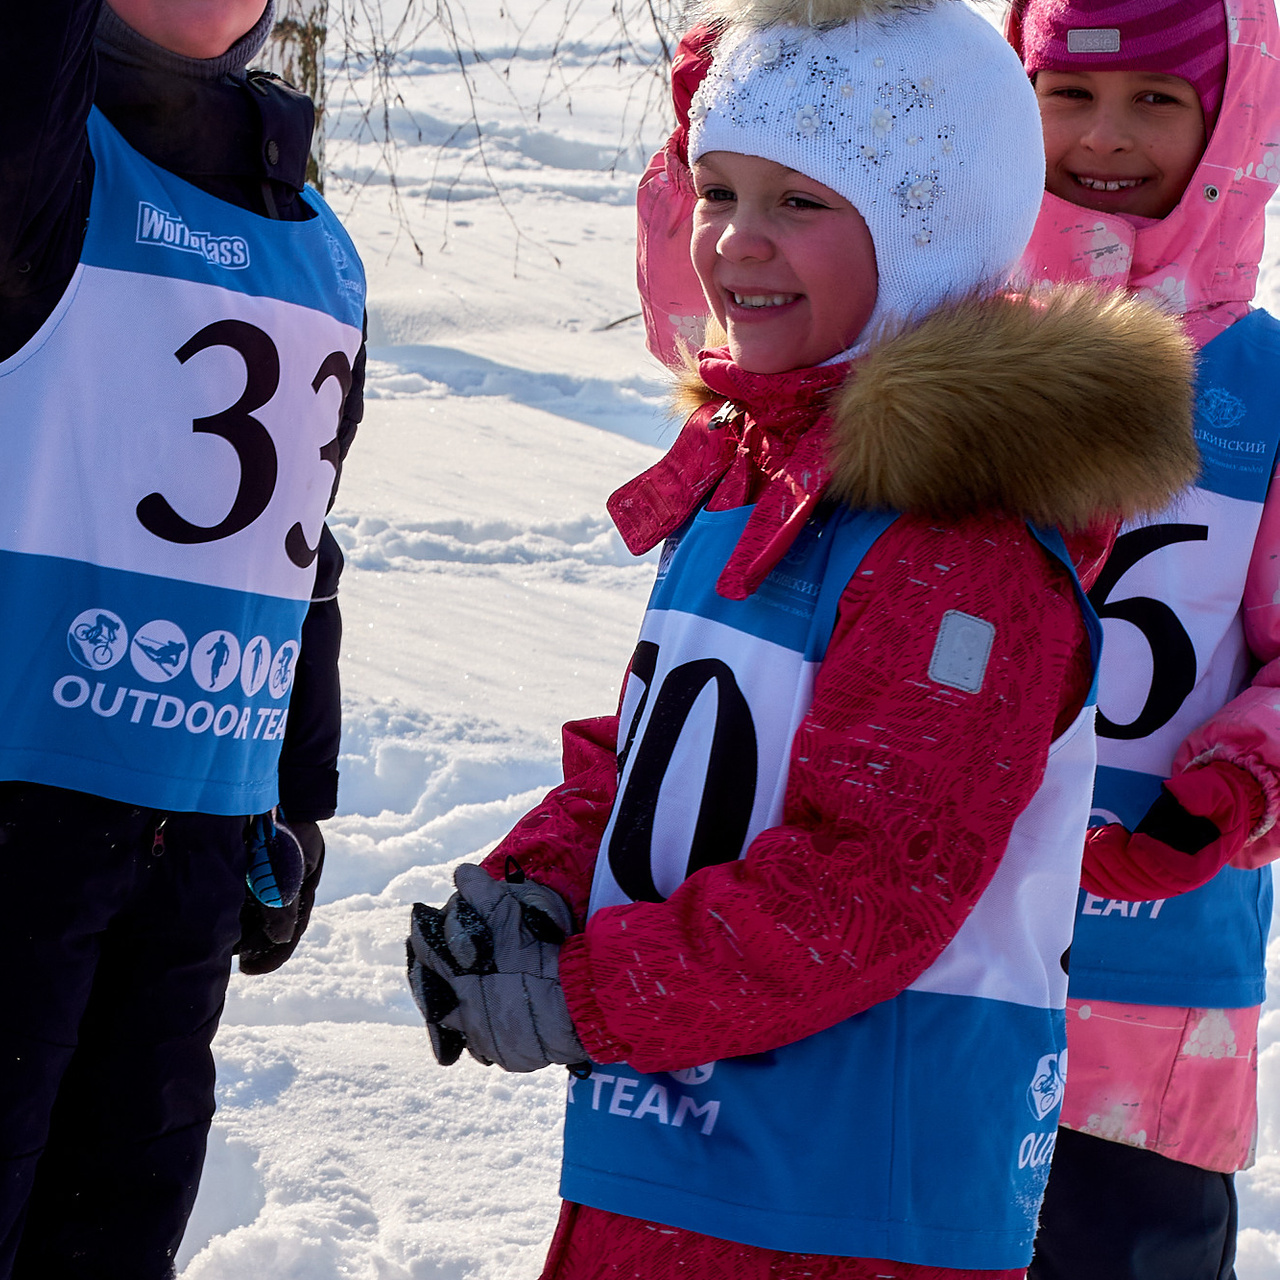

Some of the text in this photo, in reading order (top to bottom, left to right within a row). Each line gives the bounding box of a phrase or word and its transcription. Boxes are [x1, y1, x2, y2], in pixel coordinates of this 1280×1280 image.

[136, 318, 354, 570] 33
[52, 674, 288, 740] OUTDOOR TEA
[1081, 892, 1167, 919] EAM
[588, 1071, 721, 1136] TEAM
